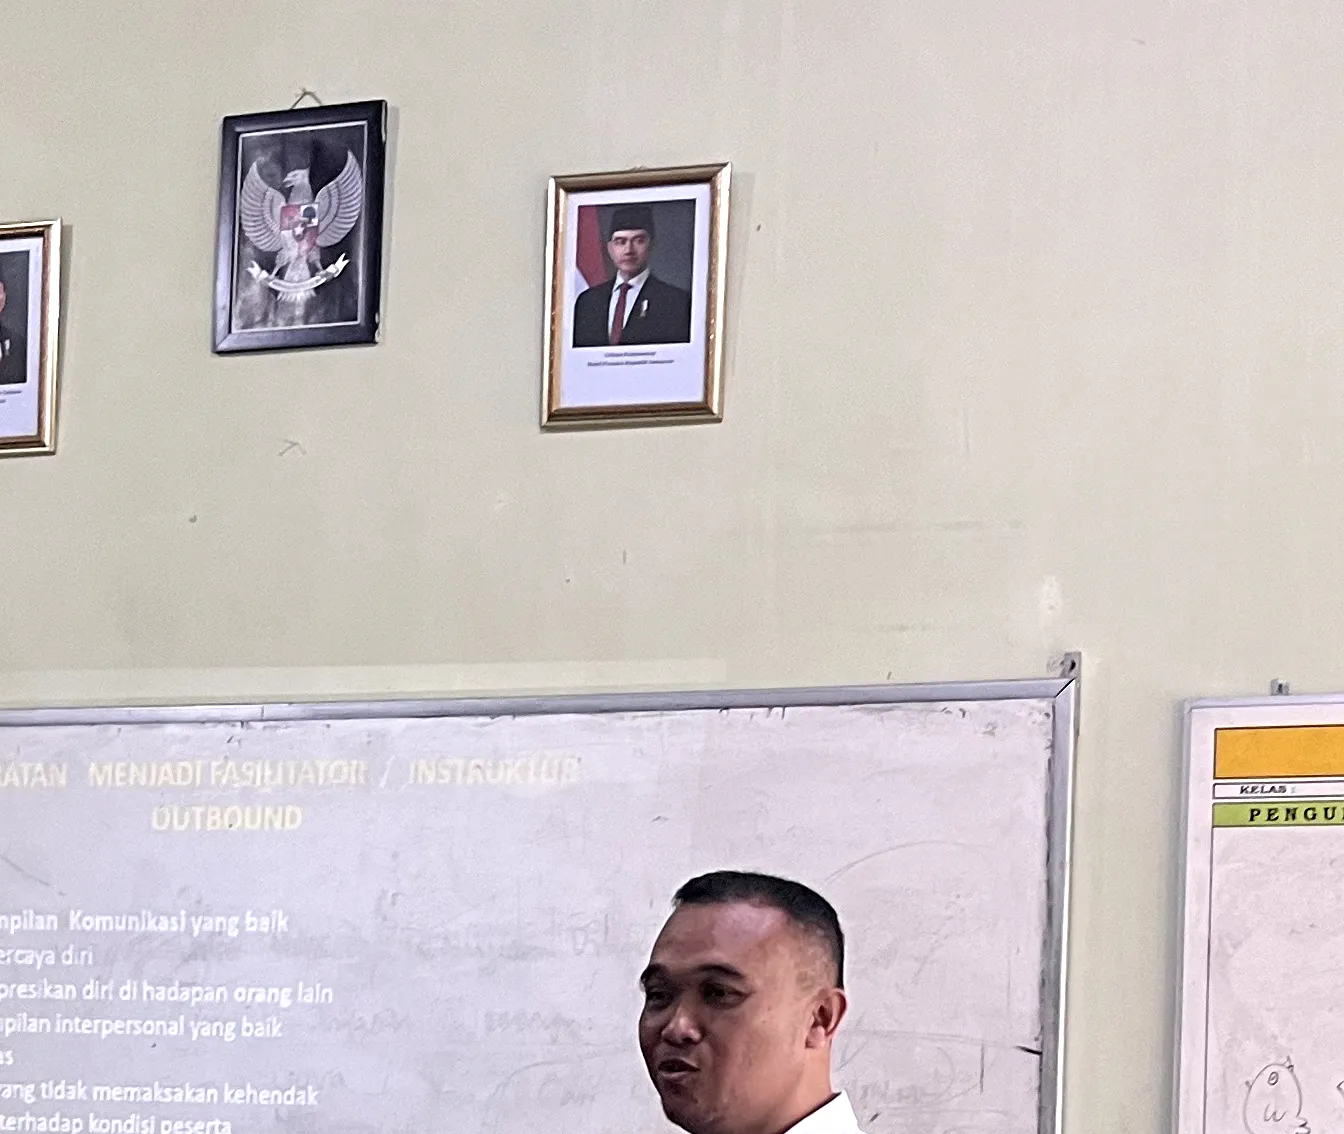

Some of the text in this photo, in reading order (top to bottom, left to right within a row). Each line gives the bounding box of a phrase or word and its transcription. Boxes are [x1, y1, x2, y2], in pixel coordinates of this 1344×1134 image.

[87, 759, 203, 788] MENJADI
[151, 804, 303, 832] OUTBOUND
[69, 910, 187, 933] Komunikasi
[191, 914, 239, 938] yang
[244, 909, 289, 933] baik
[61, 943, 94, 966] diri
[82, 978, 114, 1001] diri
[119, 979, 137, 1002] di
[142, 979, 229, 1007] hadapan
[233, 984, 293, 1008] orang
[297, 980, 334, 1004] lain
[56, 1013, 185, 1040] interpersonal
[189, 1019, 237, 1042] yang
[241, 1015, 284, 1039] baik
[40, 1079, 88, 1102] tidak
[92, 1081, 219, 1104] memaksakan
[223, 1082, 320, 1106] kehendak
